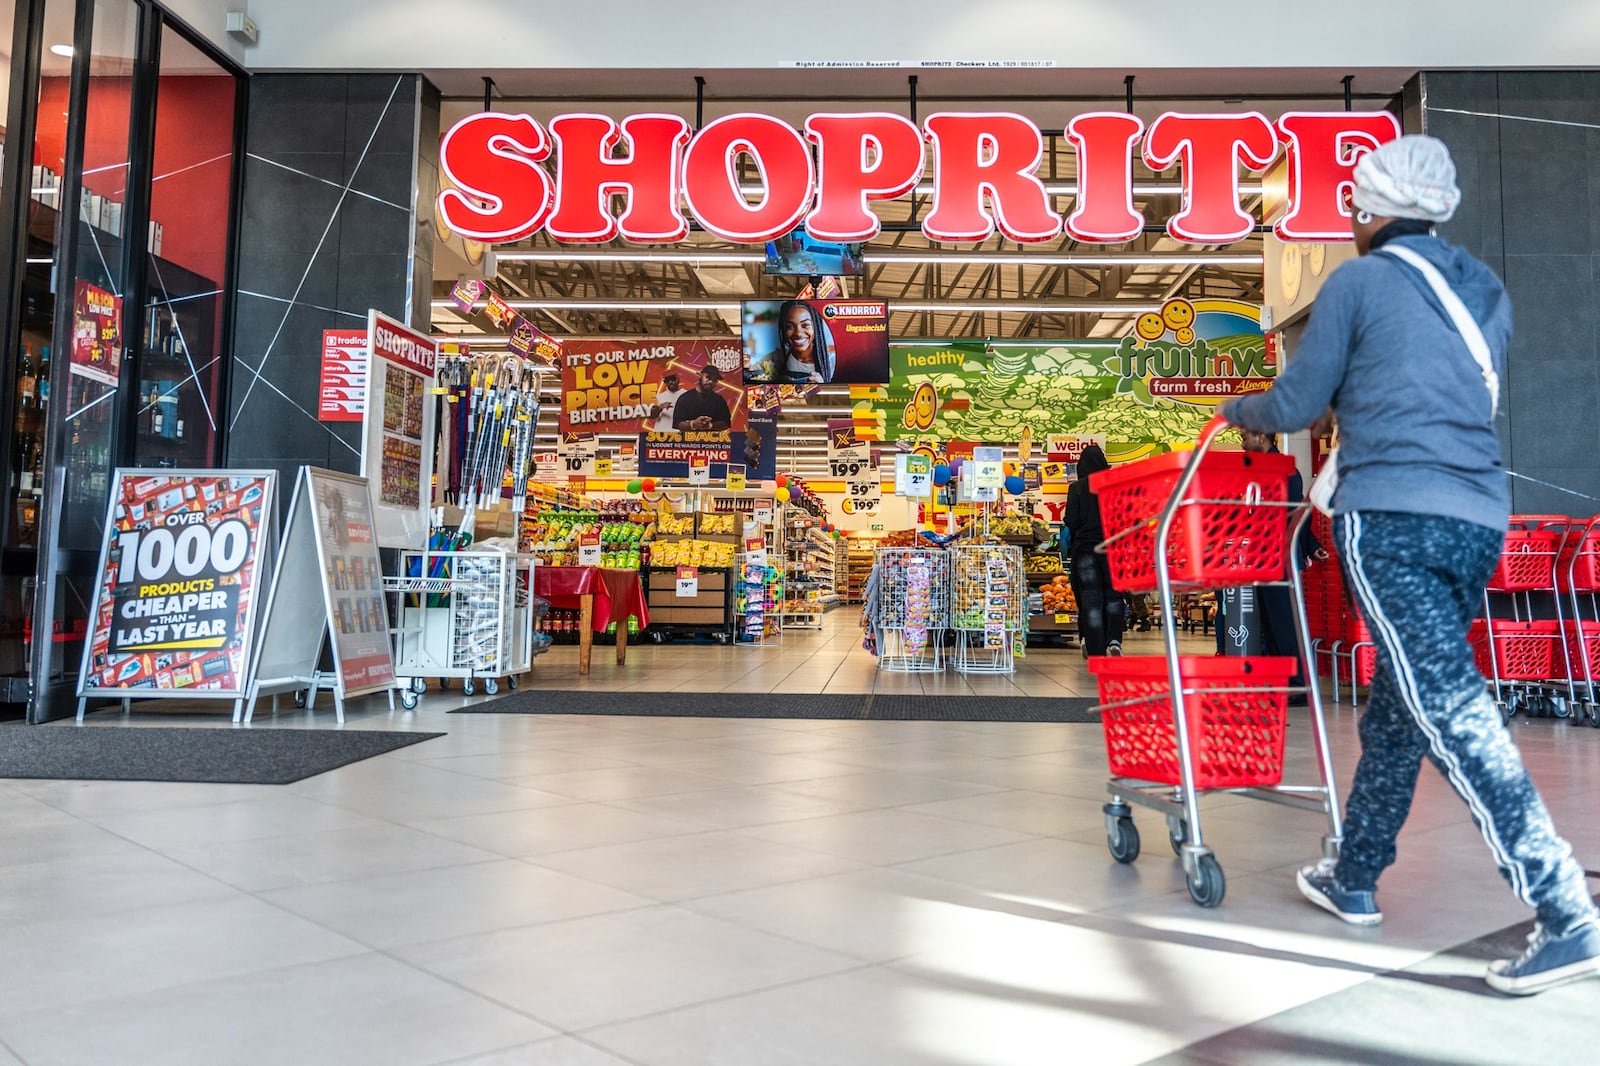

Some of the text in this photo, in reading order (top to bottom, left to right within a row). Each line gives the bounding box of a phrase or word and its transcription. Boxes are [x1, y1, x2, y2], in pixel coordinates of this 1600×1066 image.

[437, 112, 1403, 243] SHOPRITE
[840, 306, 882, 315] KNORROX
[338, 337, 367, 346] trading
[376, 326, 434, 370] SHOPRITE
[567, 346, 675, 367] IT'S OUR MAJOR
[907, 350, 965, 367] healthy
[575, 360, 650, 390] LOW
[1154, 381, 1187, 392] farm
[1194, 381, 1231, 392] fresh
[566, 383, 658, 414] PRICE
[570, 403, 655, 424] BIRTHDAY
[685, 431, 731, 442] BACK
[649, 449, 728, 460] EVERYTHING
[909, 465, 926, 473] R10
[166, 512, 204, 527] OVER
[118, 520, 248, 584] 1000
[139, 578, 215, 598] PRODUCTS
[121, 591, 228, 619] CHEAPER
[159, 614, 187, 625] THAN
[116, 619, 227, 647] LAST YEAR
